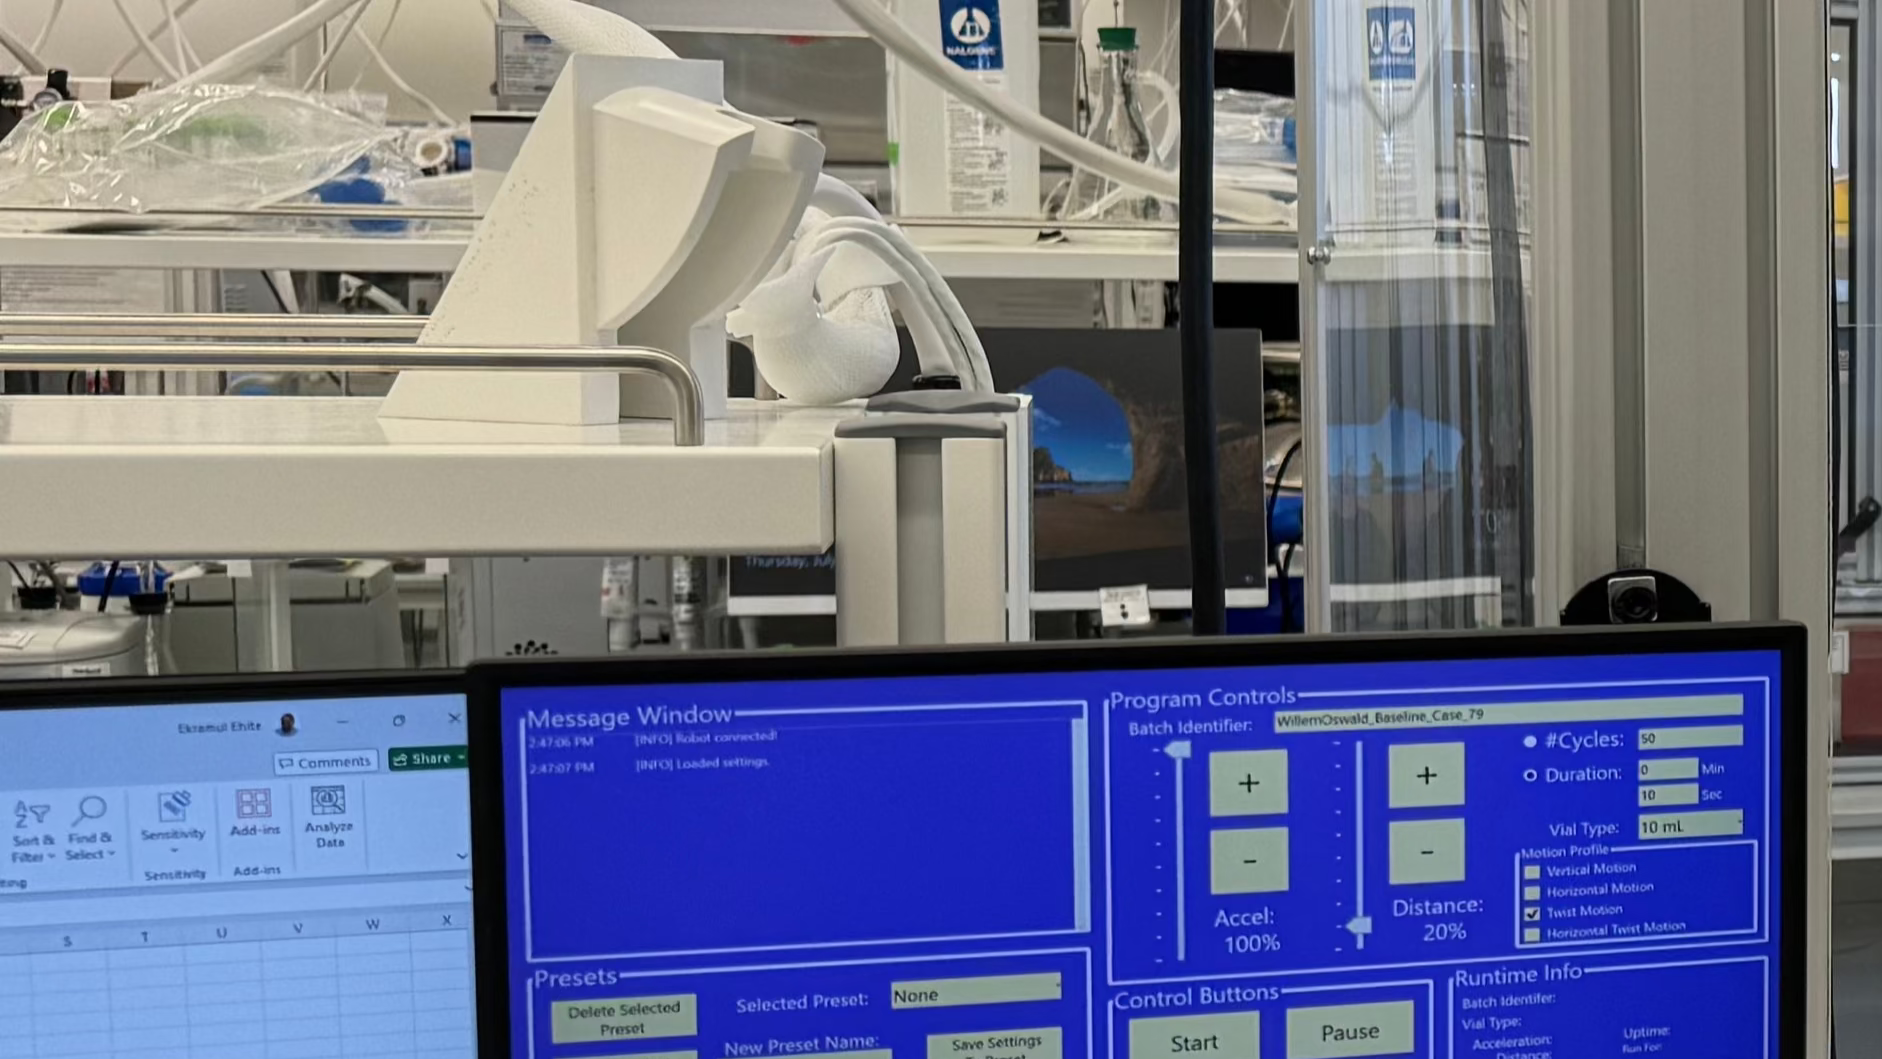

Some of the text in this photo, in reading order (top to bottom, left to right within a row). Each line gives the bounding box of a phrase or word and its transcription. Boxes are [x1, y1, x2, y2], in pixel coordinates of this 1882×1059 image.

[1110, 686, 1296, 714] Program Controls
[527, 705, 732, 731] Message Window
[1129, 717, 1253, 736] Batch Identifier:
[575, 736, 594, 747] PM
[676, 732, 711, 744] Robot
[1545, 730, 1624, 753] #Cycles:
[1640, 732, 1656, 745] 50
[298, 755, 371, 770] Comments
[412, 752, 451, 765] Share
[575, 762, 595, 773] PM
[677, 758, 719, 770] Loaded
[1545, 766, 1622, 783] Duration:
[1640, 764, 1648, 776] 0
[1702, 763, 1725, 775] Min
[1641, 789, 1656, 801] 10
[1702, 789, 1723, 801] Sec
[230, 824, 281, 837] Add-ins
[305, 821, 353, 835] Analyze
[1549, 820, 1620, 839] Vial Type:
[1642, 821, 1658, 834] 10
[13, 834, 40, 847] Sort
[68, 833, 97, 845] Find
[141, 829, 206, 842] Sensitivity
[316, 837, 345, 849] Data
[11, 851, 44, 863] Filter
[65, 849, 104, 862] Select
[1521, 844, 1609, 860] Motion Profile
[144, 869, 207, 882] Sensitivity
[233, 866, 281, 877] Add-ins
[1547, 862, 1637, 878] Vertical Motion
[1547, 881, 1654, 899] Horizontal Motion
[1393, 898, 1484, 917] Distance:
[1547, 904, 1623, 919] Twist Motion
[1214, 906, 1275, 928] Accel:
[63, 914, 452, 947] S T U V W X
[1423, 922, 1467, 942] 20%
[1547, 920, 1686, 940] Horizontal Twist Motion
[1224, 934, 1281, 954] 100%
[534, 968, 618, 988] Presets
[1455, 962, 1583, 988] Runtime Info
[737, 992, 869, 1014] Selected Preset:
[893, 988, 939, 1005] None
[1115, 985, 1279, 1010] Control Buttons
[1462, 996, 1497, 1010] Batch
[568, 1000, 681, 1019] Delete Selected
[600, 1022, 645, 1036] Preset
[1462, 1016, 1522, 1031] Vial Type:
[1321, 1024, 1380, 1042] Pause
[1623, 1026, 1671, 1041] Uptime:
[724, 1033, 880, 1058] New Preset Name:
[952, 1034, 1042, 1052] Save Settings
[1171, 1034, 1219, 1053] Start
[1472, 1035, 1553, 1050] Acceleration:
